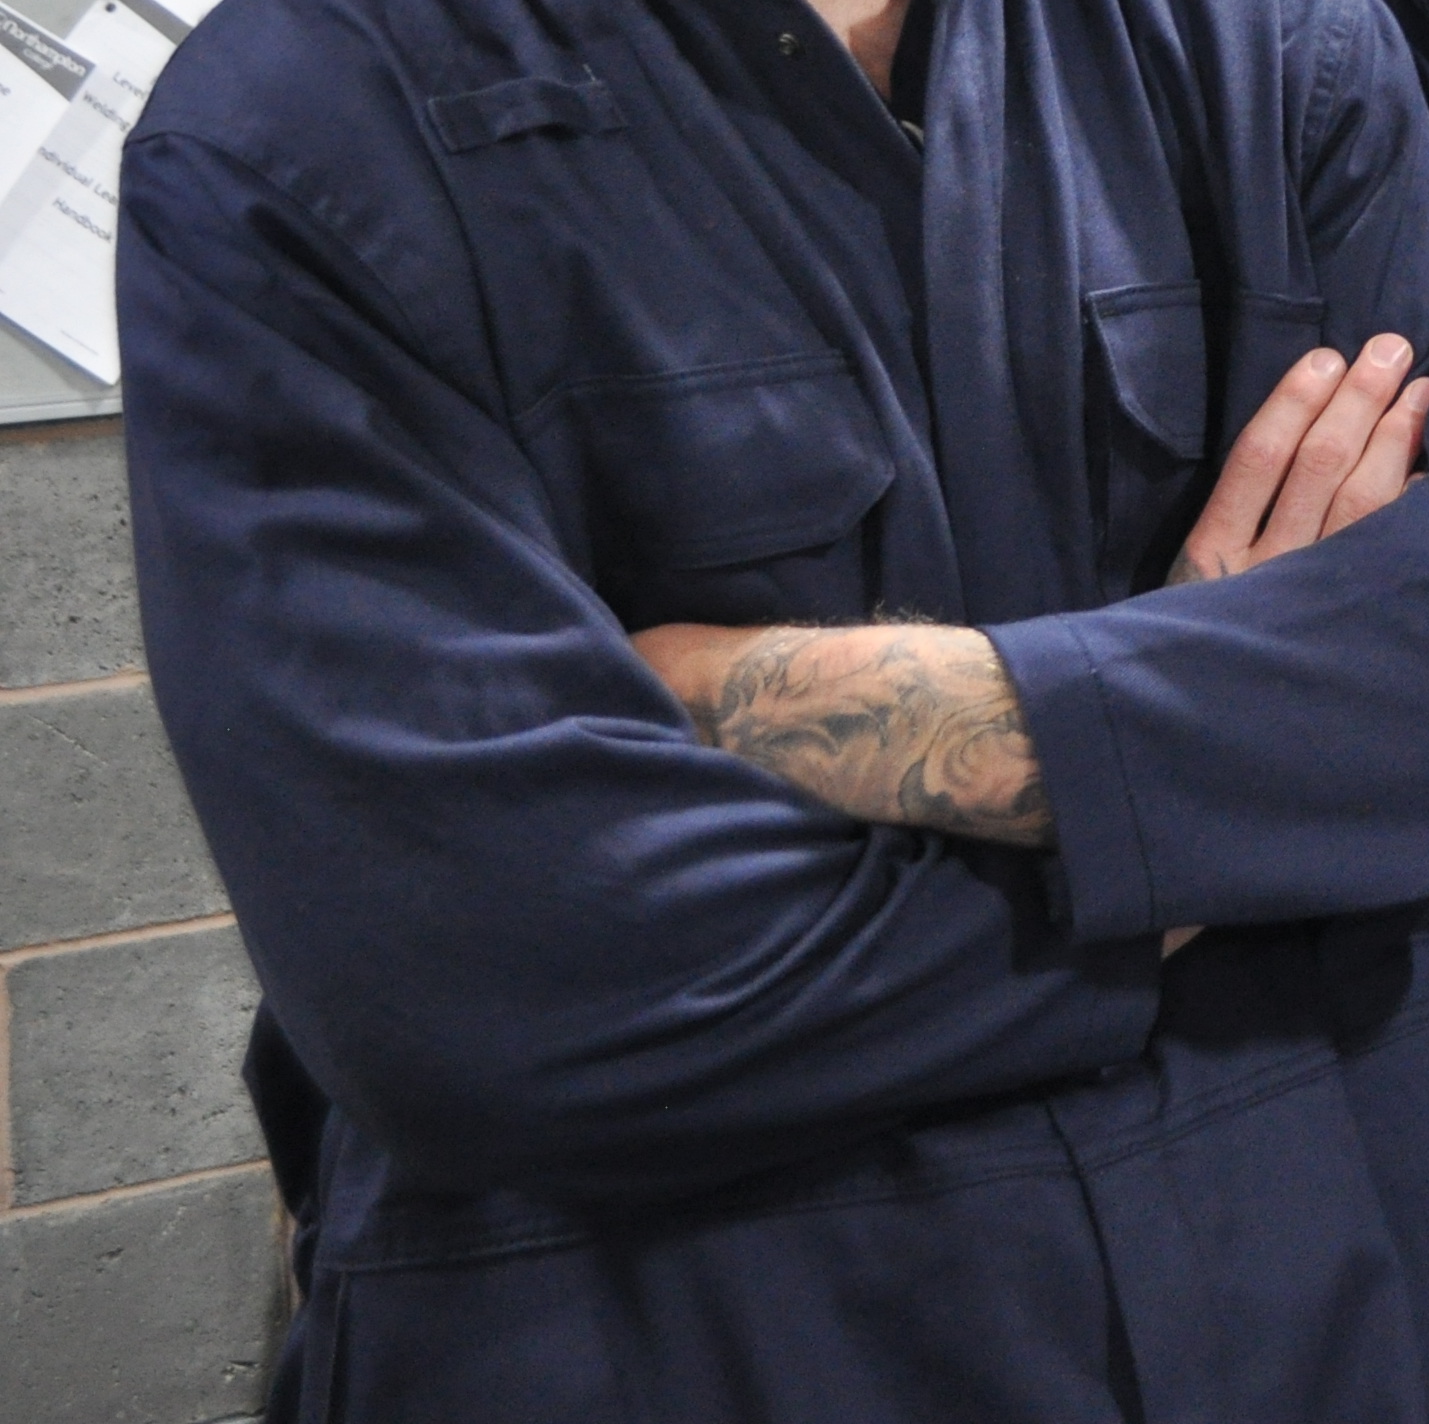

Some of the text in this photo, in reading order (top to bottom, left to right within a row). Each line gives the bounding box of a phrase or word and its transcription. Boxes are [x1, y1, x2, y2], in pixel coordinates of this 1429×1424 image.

[3, 19, 87, 76] Northampton
[83, 90, 131, 132] Welding
[52, 196, 112, 243] Handbook
